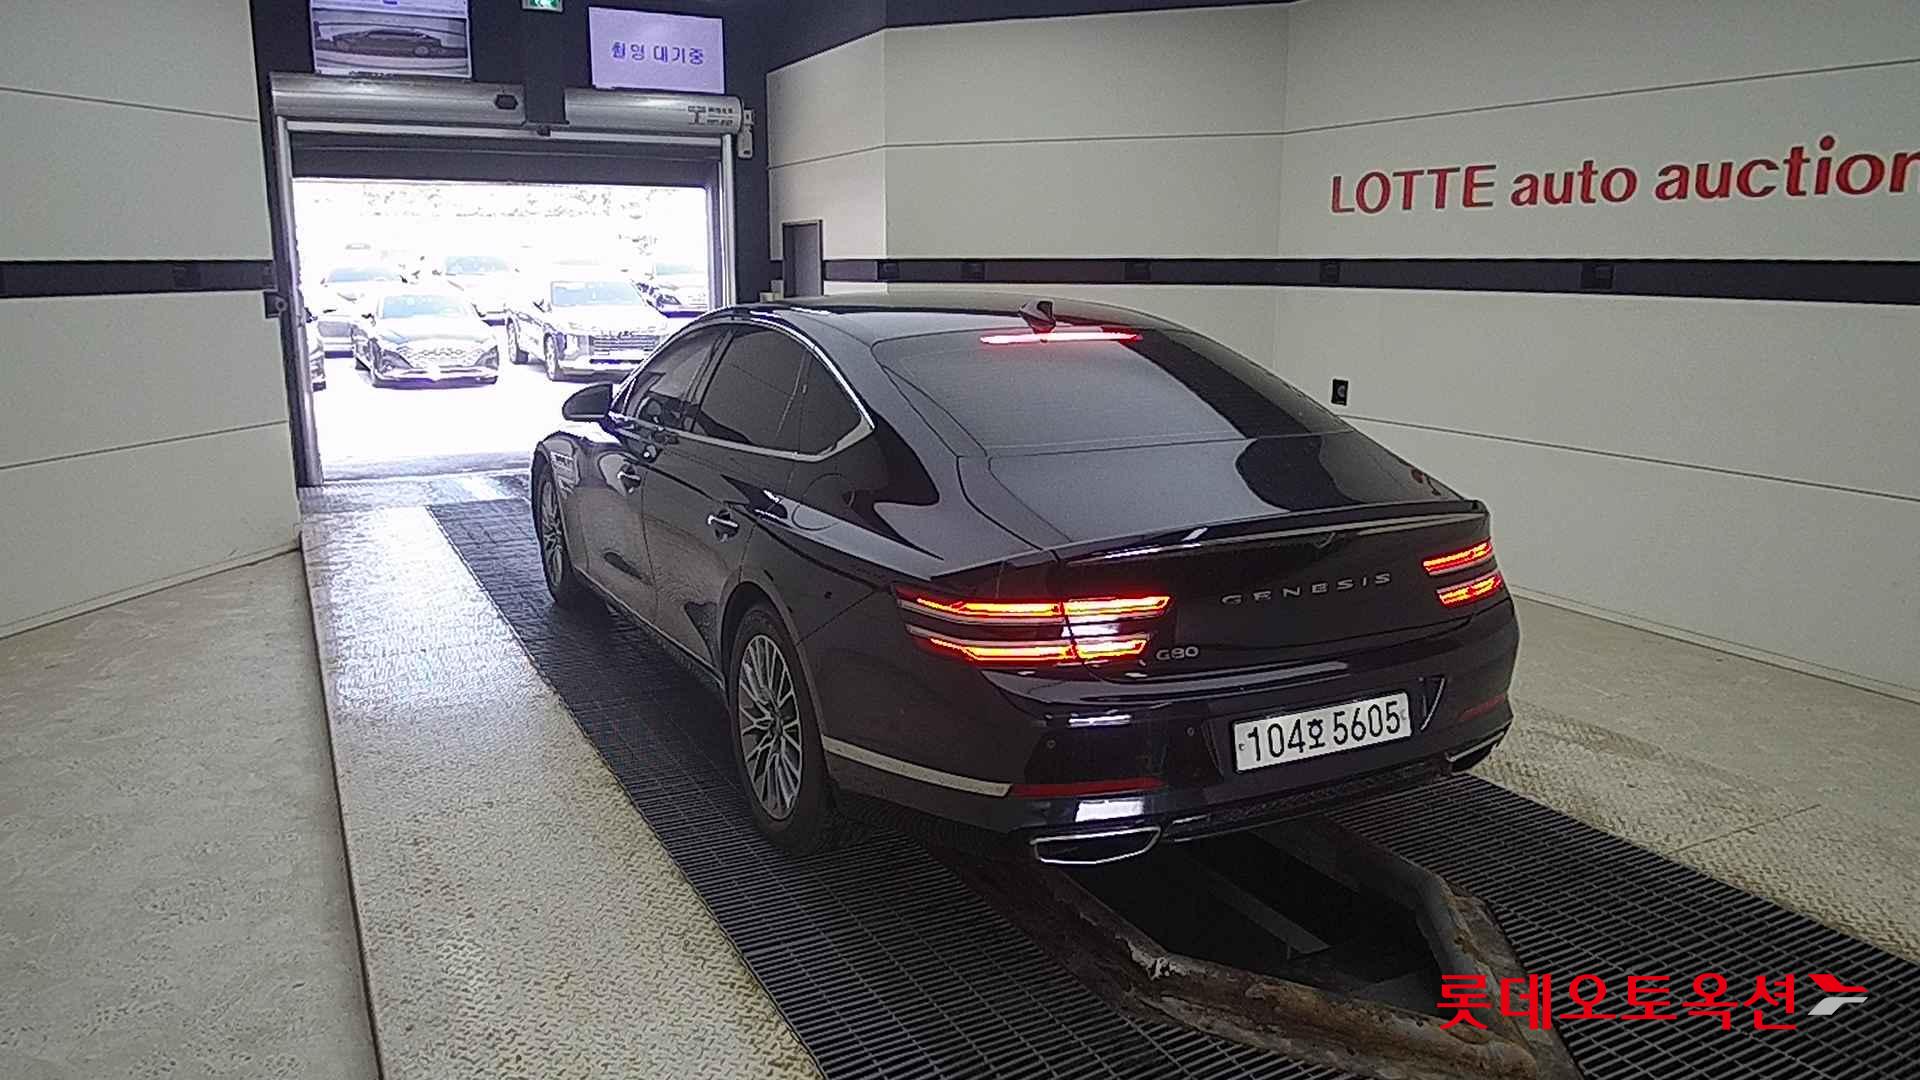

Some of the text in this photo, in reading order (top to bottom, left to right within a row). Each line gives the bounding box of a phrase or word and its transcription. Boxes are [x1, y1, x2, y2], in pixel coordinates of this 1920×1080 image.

[653, 45, 704, 65] 대기중
[1331, 164, 1496, 213] LOTTE
[1510, 159, 1637, 206] auto
[1221, 572, 1391, 605] GENESIS
[1156, 646, 1199, 661] G80
